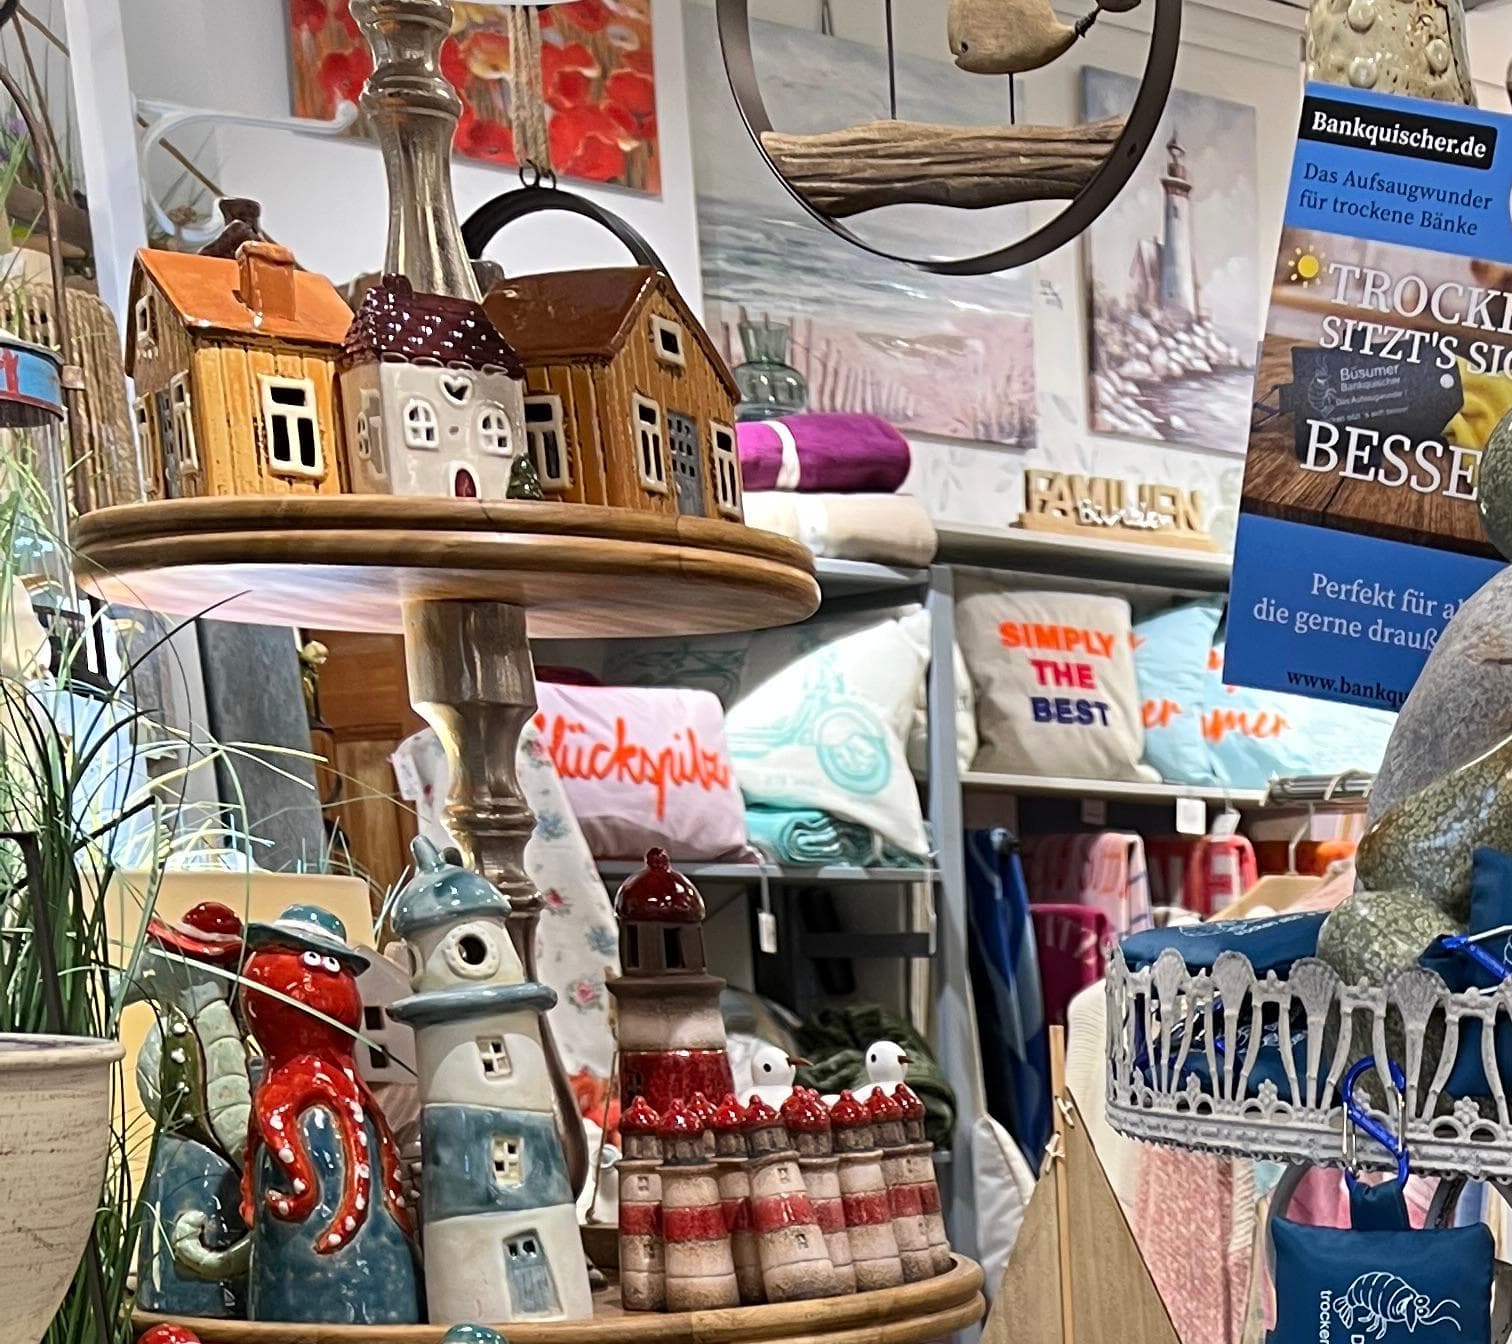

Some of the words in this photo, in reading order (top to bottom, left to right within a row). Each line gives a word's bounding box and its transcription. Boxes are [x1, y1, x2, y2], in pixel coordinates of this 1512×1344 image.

[1311, 111, 1487, 158] Bankquischer.de
[1304, 163, 1338, 183] Das
[1344, 171, 1493, 210] Aufsaugwunder
[1299, 190, 1328, 210] für
[1333, 195, 1414, 225] trockene
[1421, 212, 1478, 236] Bänke
[1319, 316, 1459, 369] SITZT'S
[1300, 419, 1483, 501] BESSE
[1311, 573, 1396, 610] Perfekt
[1401, 589, 1438, 617] für
[998, 619, 1115, 658] SIMPLY
[1253, 598, 1288, 624] die
[1294, 610, 1362, 637] gerne
[1368, 620, 1440, 652] drauß
[1029, 658, 1097, 690] THE
[1287, 670, 1409, 709] www.bankqu
[1029, 696, 1112, 727] BEST
[534, 713, 732, 822] lückspilz
